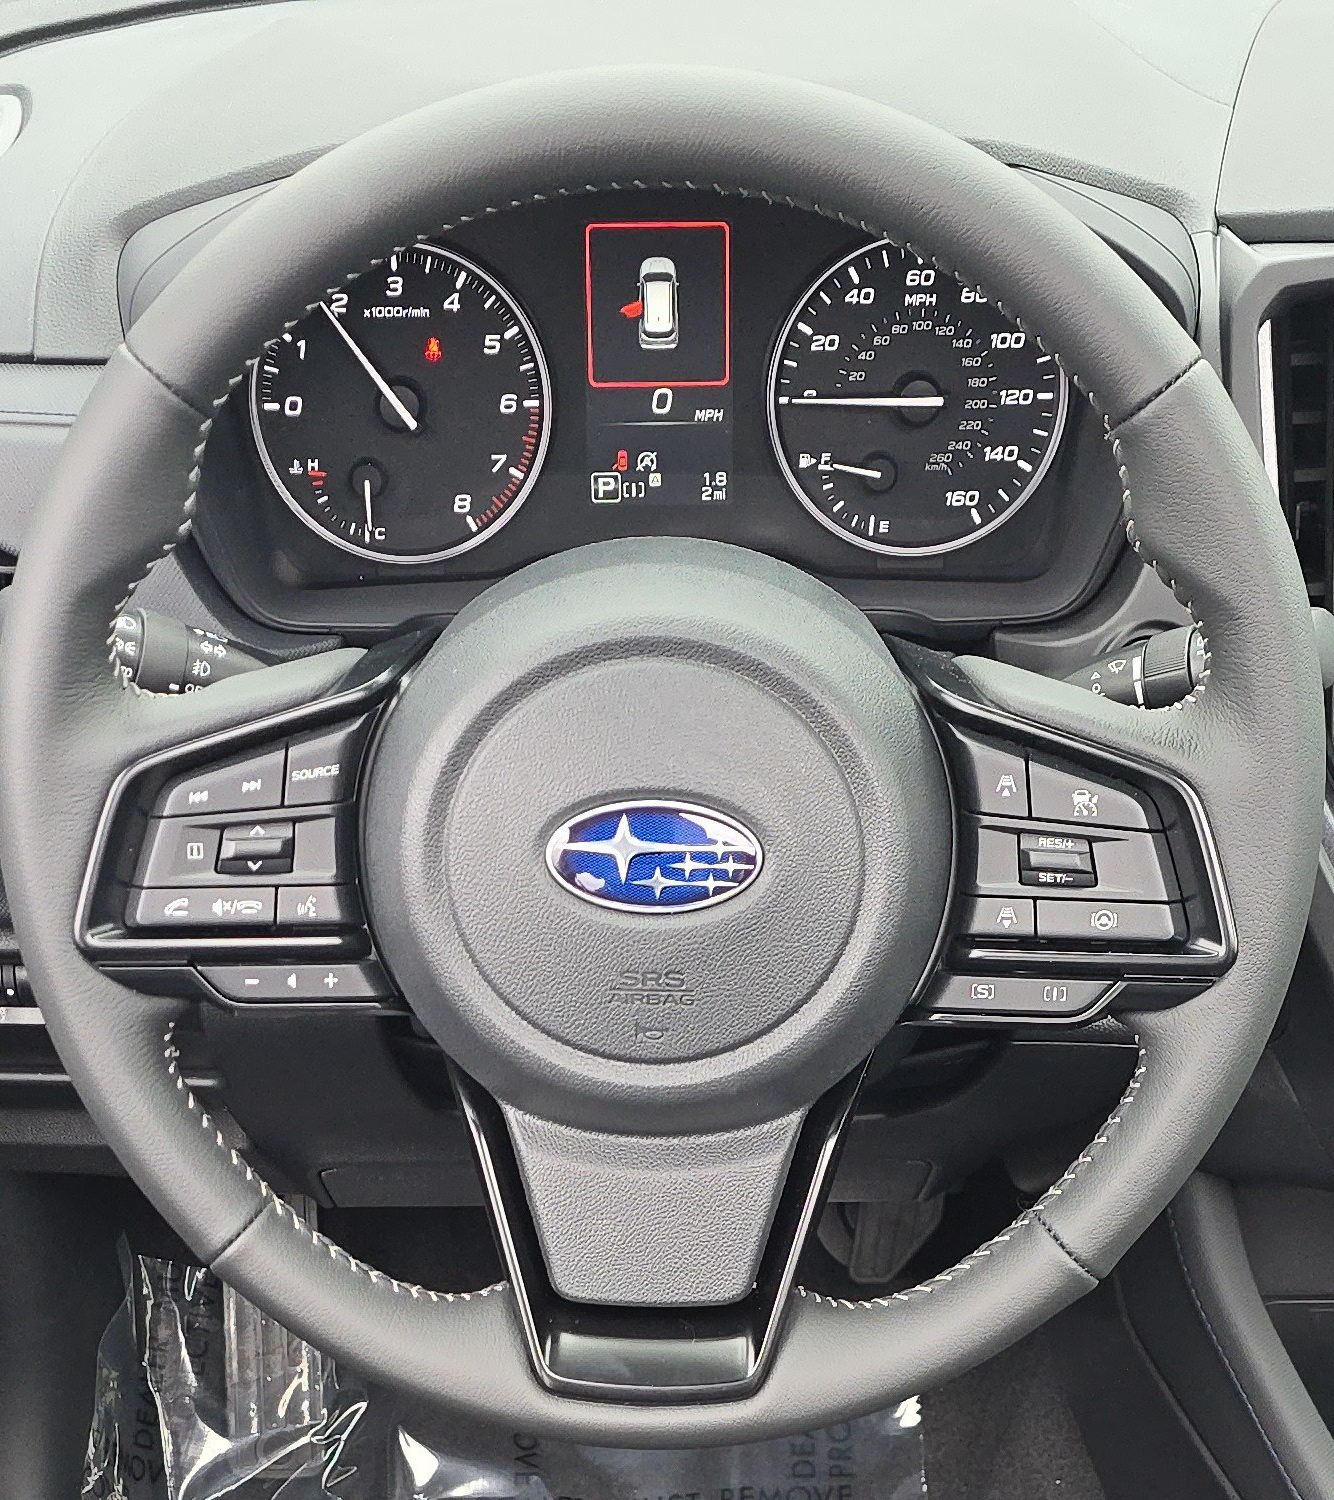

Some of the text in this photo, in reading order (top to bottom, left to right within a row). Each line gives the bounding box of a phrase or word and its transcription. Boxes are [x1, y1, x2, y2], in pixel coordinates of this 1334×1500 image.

[905, 270, 936, 286] 60
[386, 276, 403, 296] 3
[443, 292, 461, 312] 4
[844, 288, 875, 305] 40
[904, 294, 937, 306] MPH
[329, 294, 349, 314] 2
[363, 307, 430, 319] x1000r/min
[891, 324, 909, 335] 80
[911, 320, 933, 331] 100
[934, 326, 955, 336] 120
[483, 334, 501, 354] 5
[810, 335, 840, 351] 20
[873, 335, 891, 346] 60
[951, 338, 973, 349] 140
[990, 333, 1025, 349] 100
[296, 339, 307, 360] 1
[857, 351, 875, 361] 40
[960, 356, 982, 367] 160
[848, 371, 866, 382] 20
[967, 377, 988, 388] 180
[499, 393, 517, 414] 6
[651, 388, 673, 414] 0
[999, 389, 1034, 405] 120
[284, 396, 303, 416] 0
[964, 399, 988, 409] 200
[694, 409, 724, 422] MPH
[958, 420, 982, 431] 220
[947, 440, 971, 451] 240
[929, 452, 952, 463] 260
[983, 446, 1019, 461] 140
[307, 459, 319, 471] H
[491, 453, 507, 473] 7
[925, 462, 948, 472] km/h
[453, 494, 471, 513] 8
[945, 490, 980, 507] 160
[878, 521, 890, 532] E
[374, 527, 387, 540] C
[291, 763, 340, 782] SOURCE
[620, 971, 685, 988] SRS
[606, 993, 696, 1006] AIRBAG
